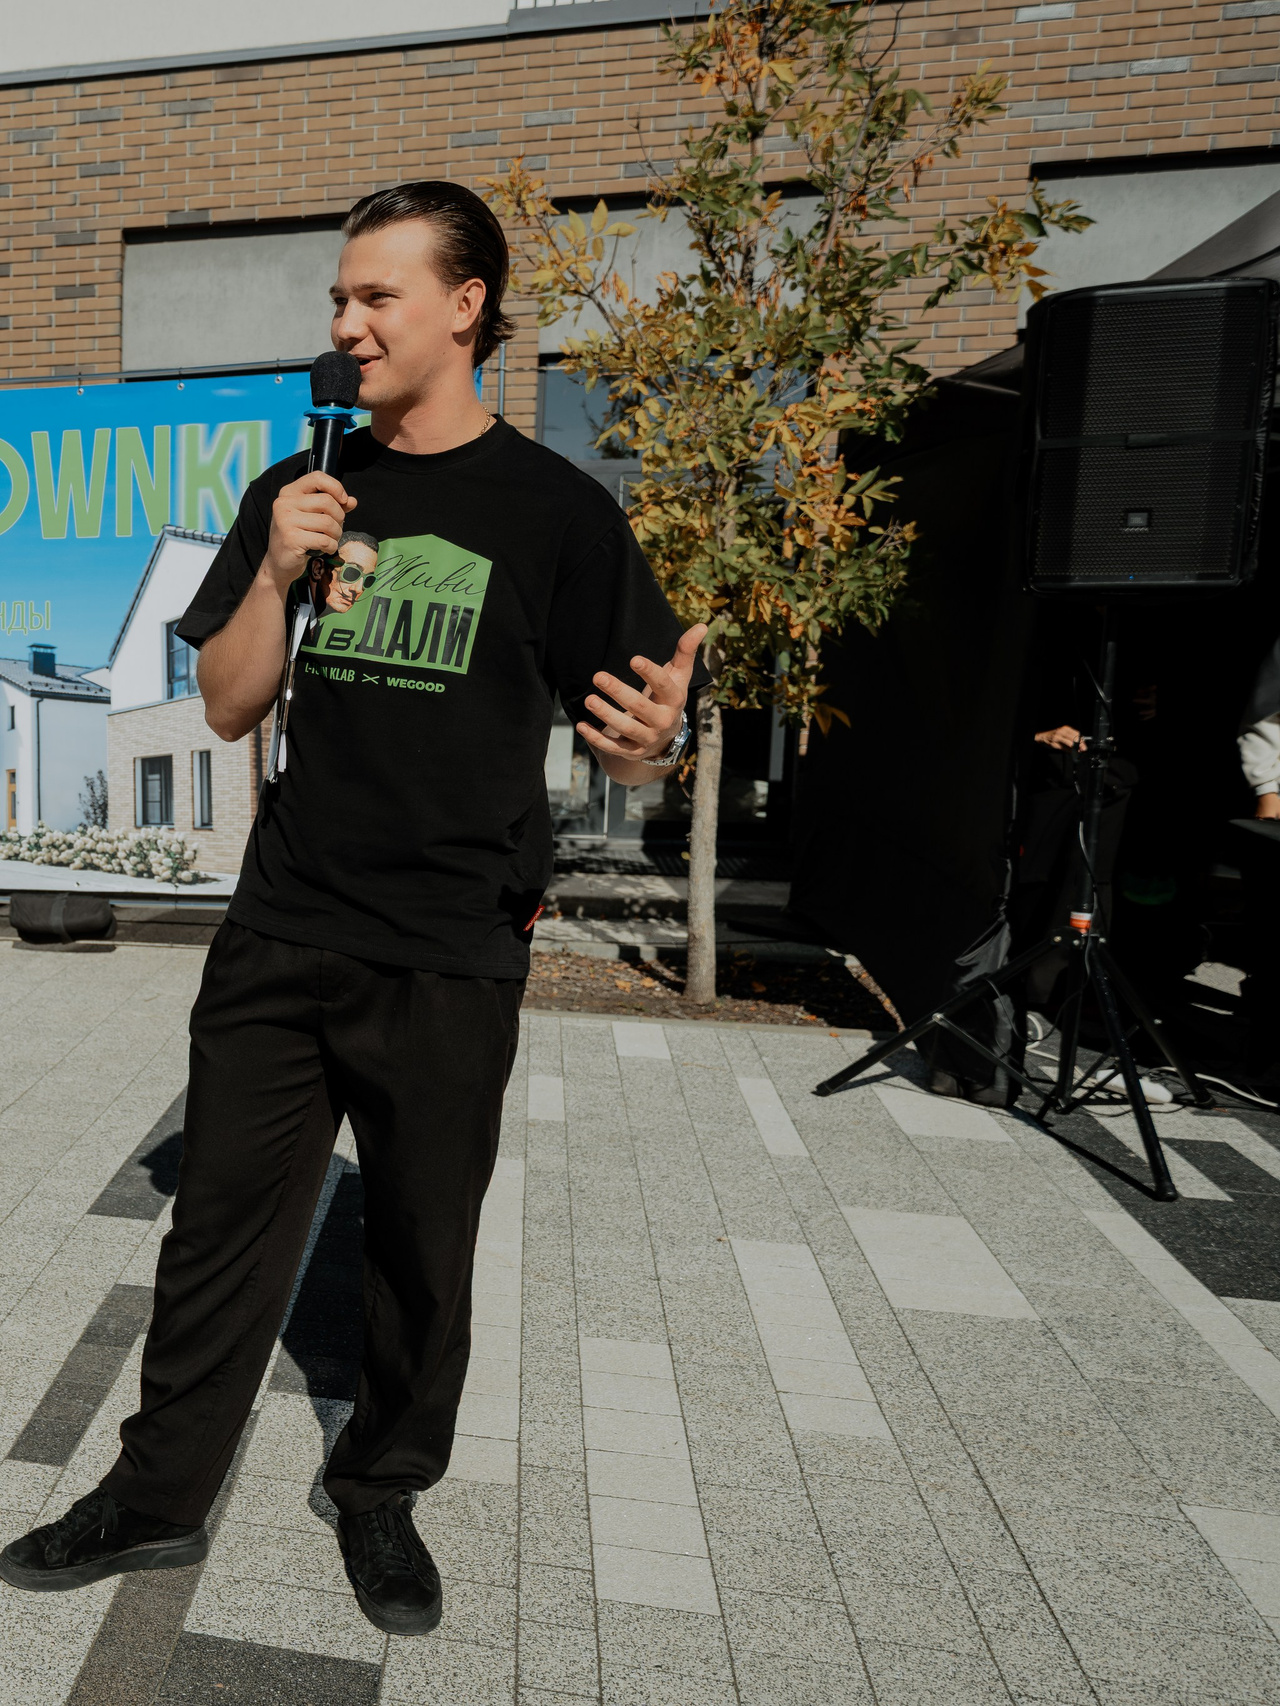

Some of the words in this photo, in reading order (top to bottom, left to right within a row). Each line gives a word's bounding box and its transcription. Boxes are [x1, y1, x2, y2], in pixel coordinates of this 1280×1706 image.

[354, 595, 475, 668] ДАЛИ
[329, 666, 356, 682] KLAB
[386, 676, 446, 693] WEGOOD
